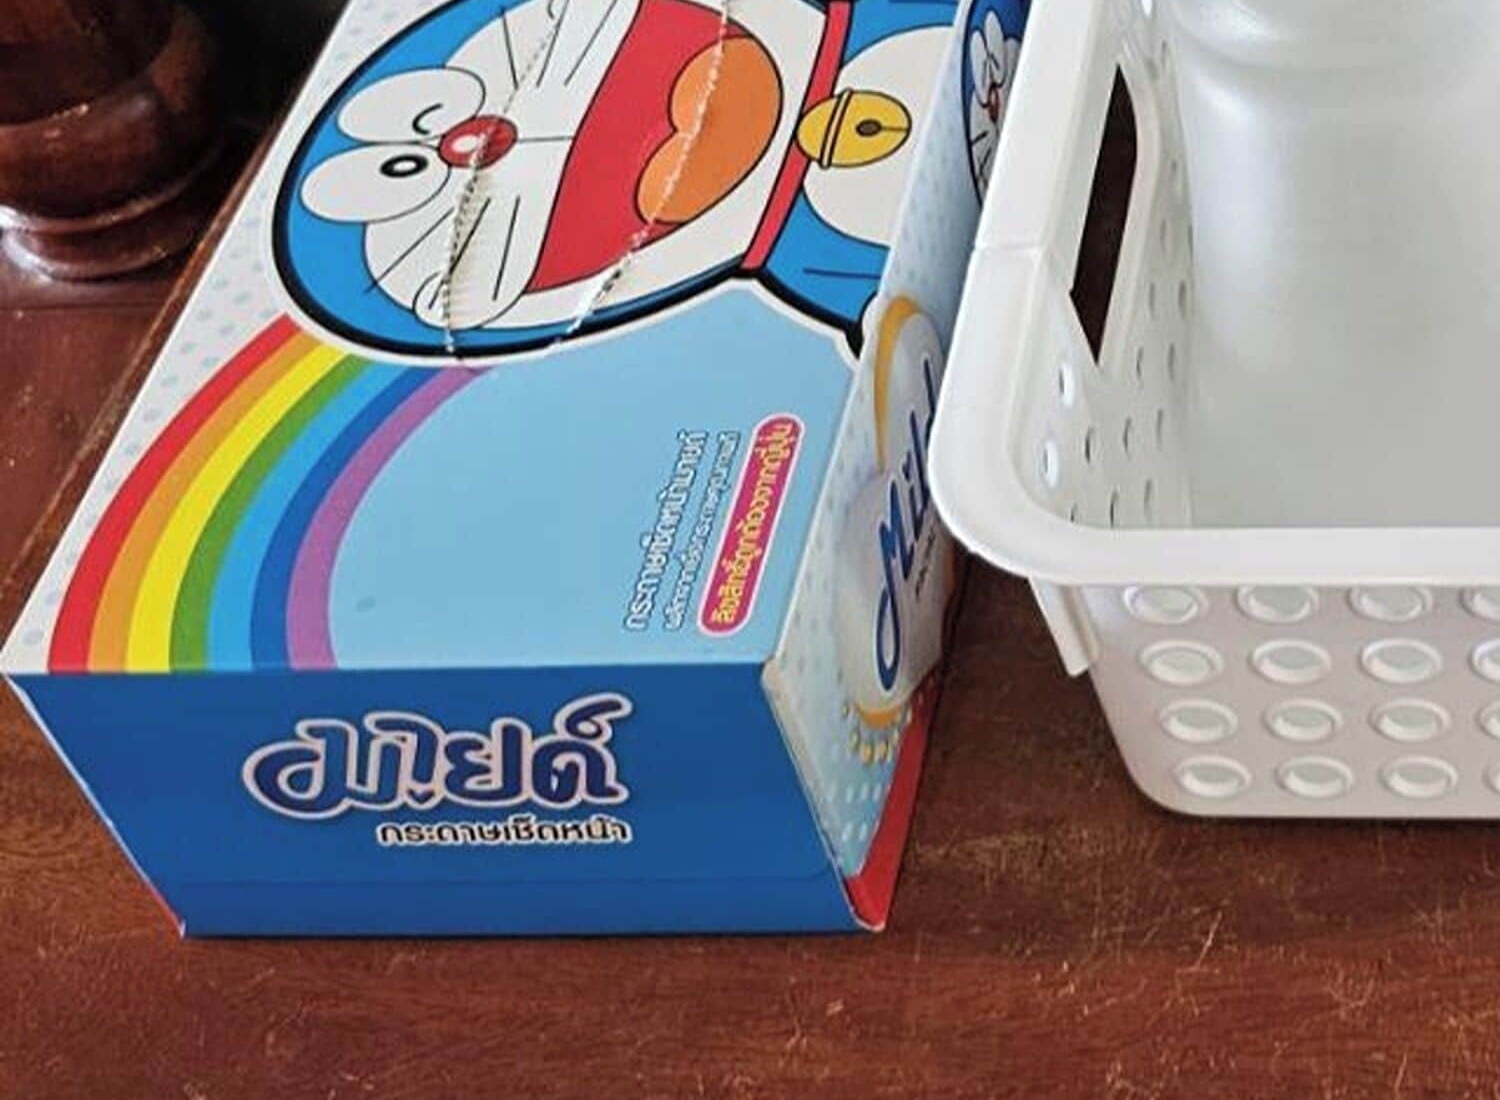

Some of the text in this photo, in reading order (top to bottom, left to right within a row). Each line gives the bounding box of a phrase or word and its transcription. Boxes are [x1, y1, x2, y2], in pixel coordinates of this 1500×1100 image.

[376, 813, 632, 846] กระดาษเช็ดหน้า
